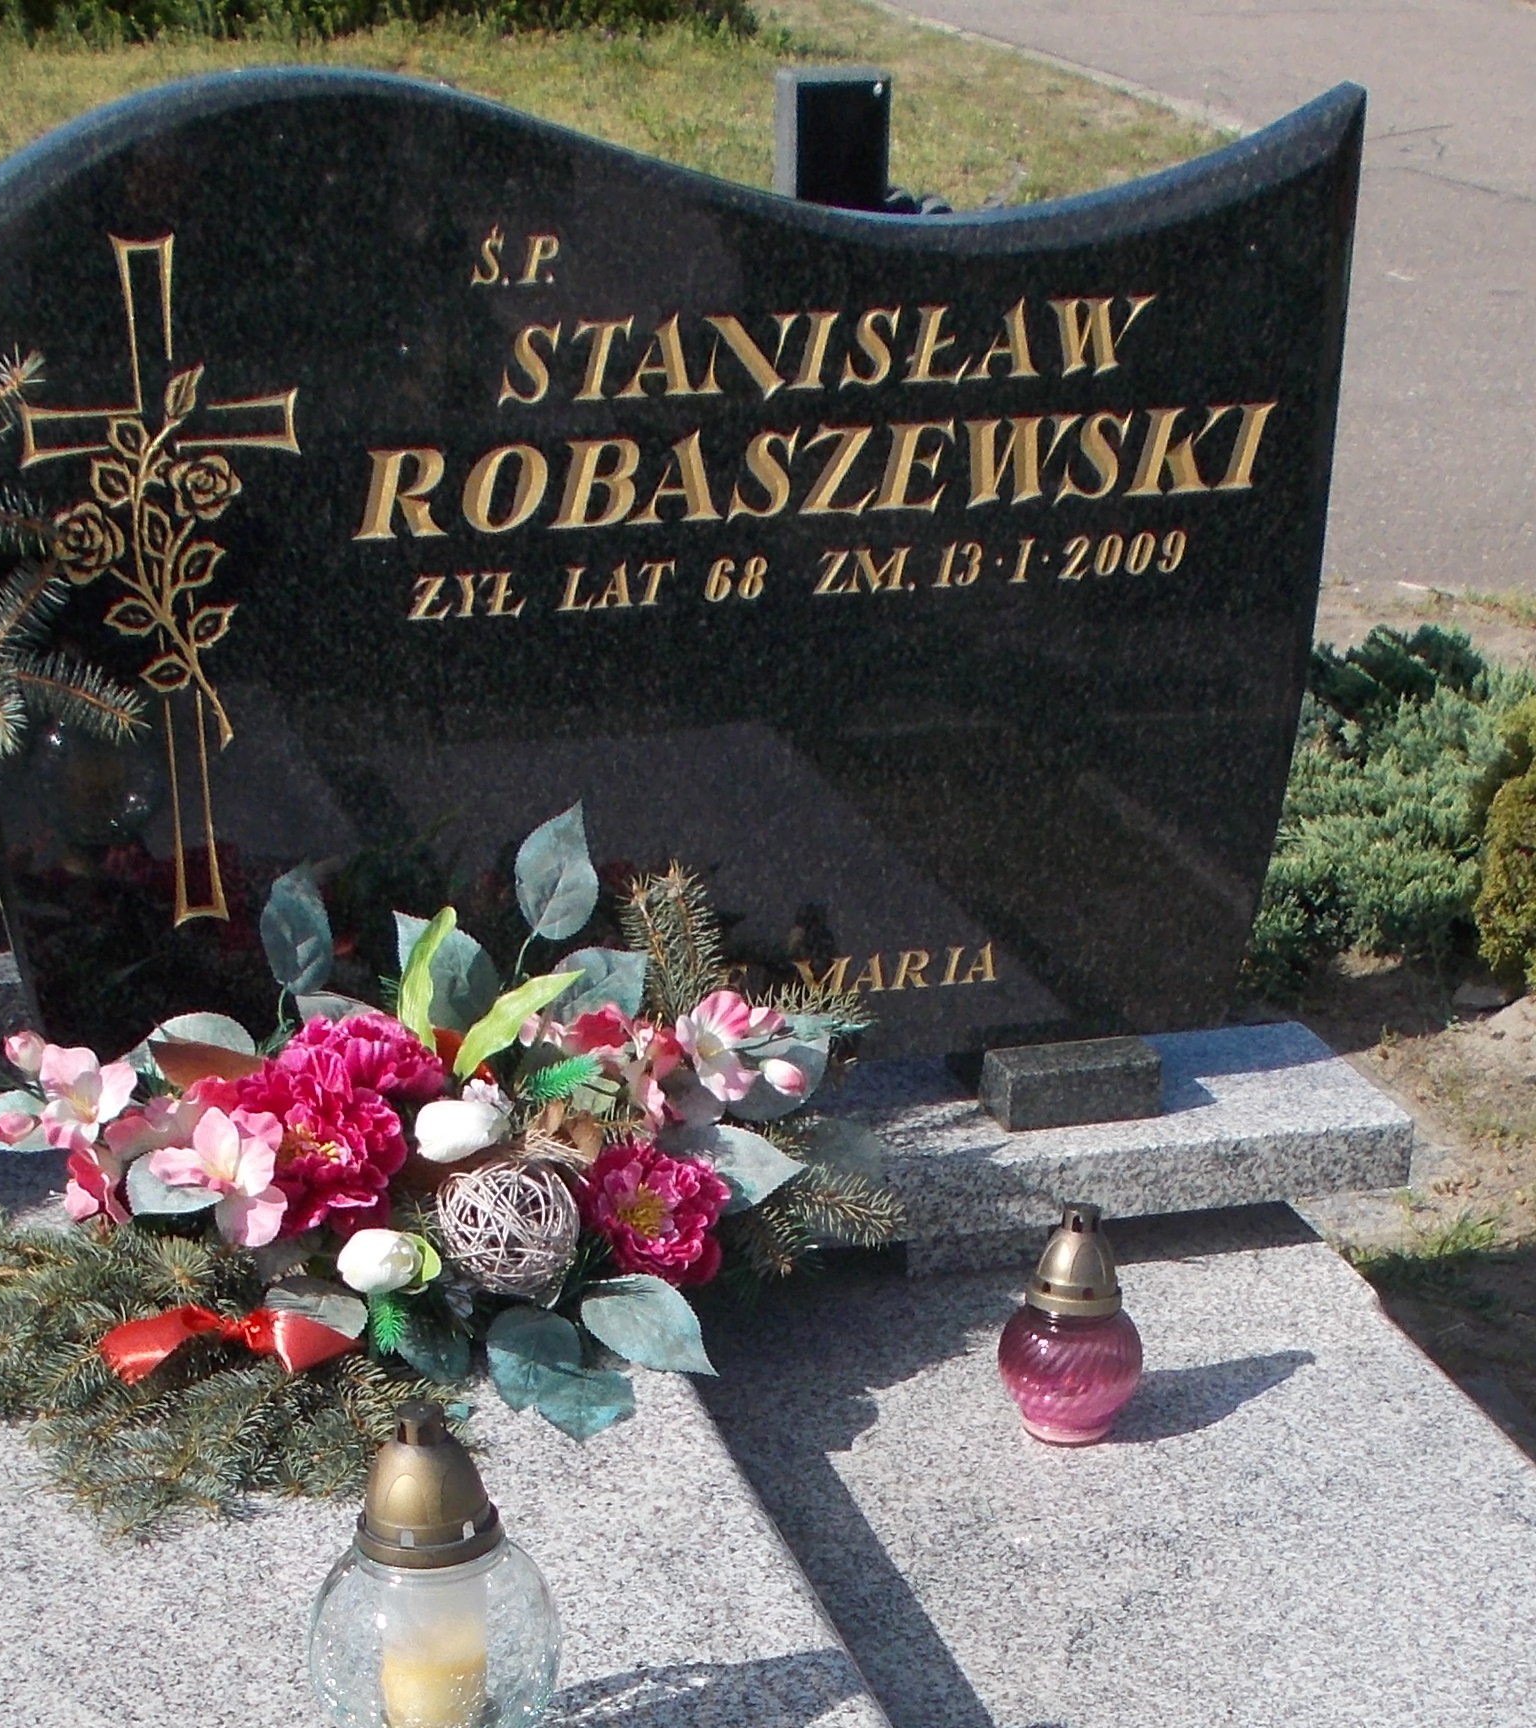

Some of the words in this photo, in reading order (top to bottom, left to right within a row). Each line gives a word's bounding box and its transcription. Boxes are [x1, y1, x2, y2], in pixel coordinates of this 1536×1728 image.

[498, 294, 1158, 407] STANISŁAW
[353, 402, 1278, 540] ROBASZEWSKI
[558, 560, 676, 611] LAT
[703, 555, 767, 601] 68
[813, 546, 916, 594] ZM.
[793, 941, 997, 994] MARIA
